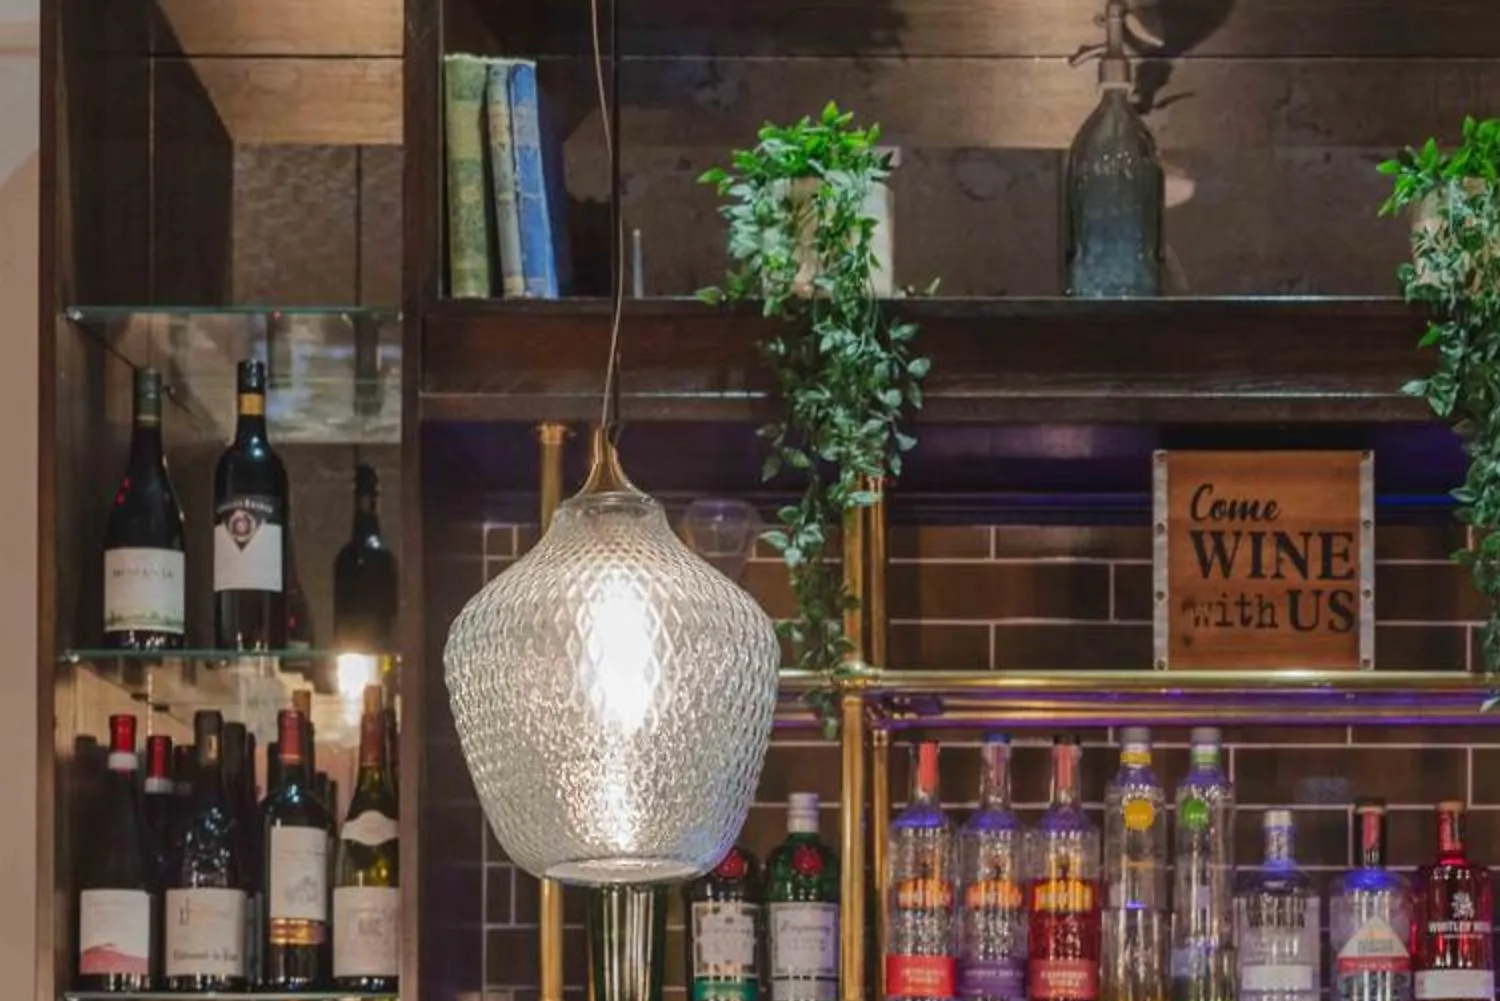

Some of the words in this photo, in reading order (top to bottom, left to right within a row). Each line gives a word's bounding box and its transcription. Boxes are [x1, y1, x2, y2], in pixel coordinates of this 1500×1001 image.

[1190, 482, 1281, 523] Come
[1189, 529, 1356, 580] WINE
[1188, 592, 1280, 630] with
[1286, 588, 1356, 633] US
